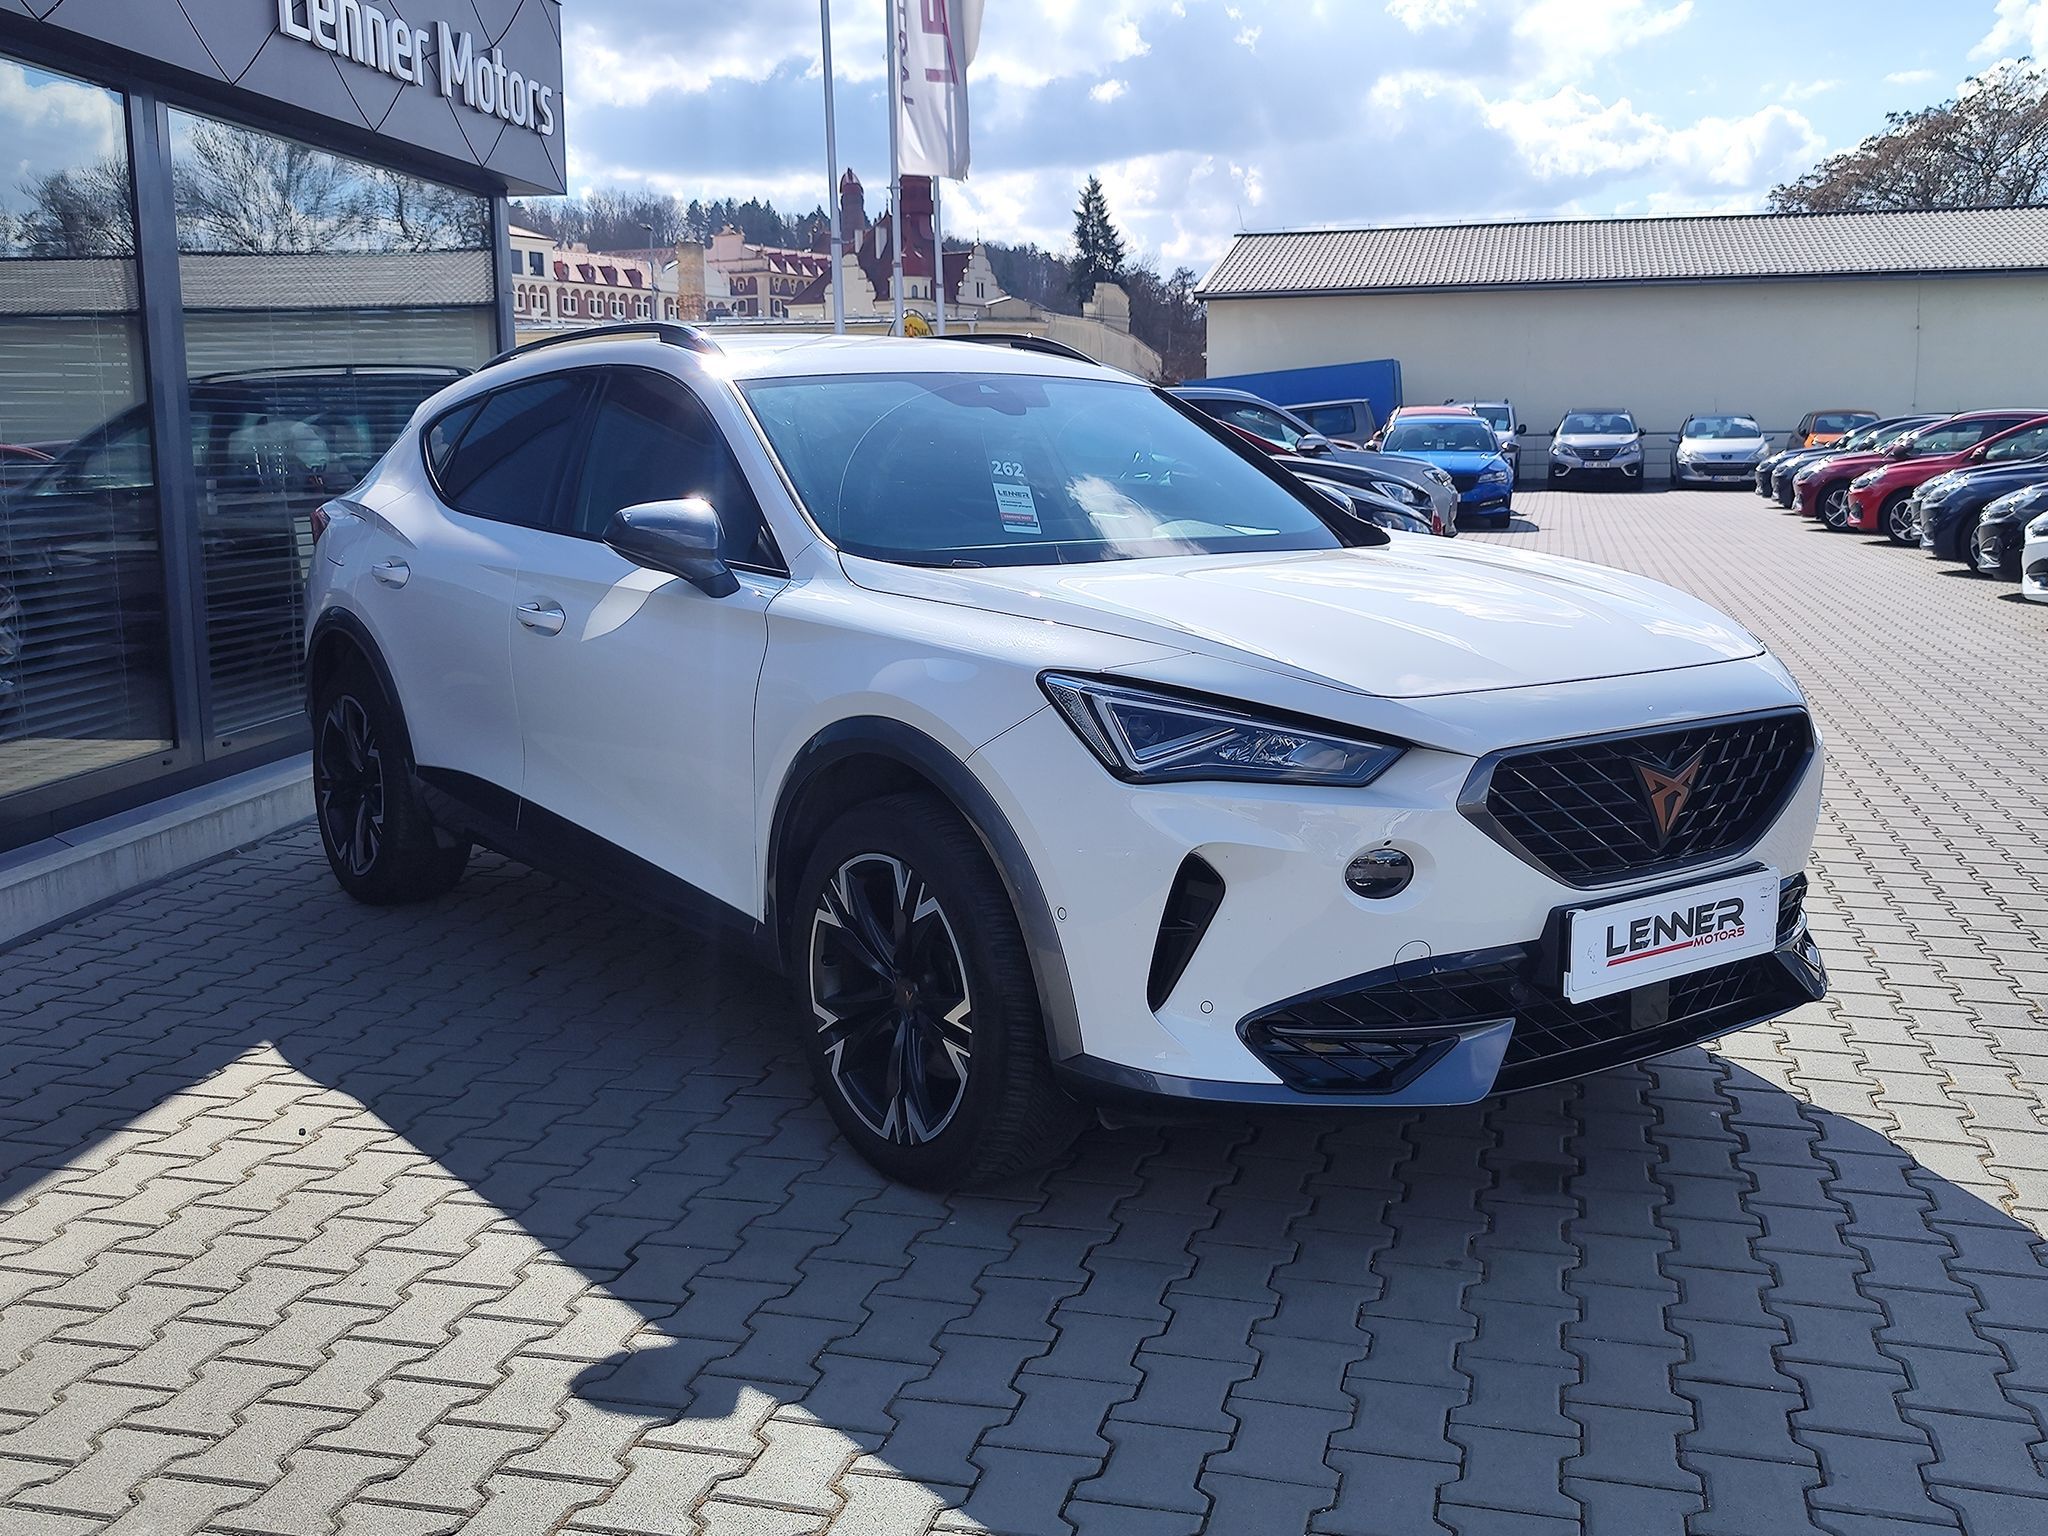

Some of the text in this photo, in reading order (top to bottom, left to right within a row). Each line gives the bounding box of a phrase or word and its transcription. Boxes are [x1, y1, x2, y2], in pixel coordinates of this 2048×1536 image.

[436, 20, 554, 136] Motors
[991, 460, 1025, 478] 262
[997, 489, 1031, 499] LENNER
[1606, 897, 1745, 957] LENNER
[1693, 927, 1746, 948] MOTORS
